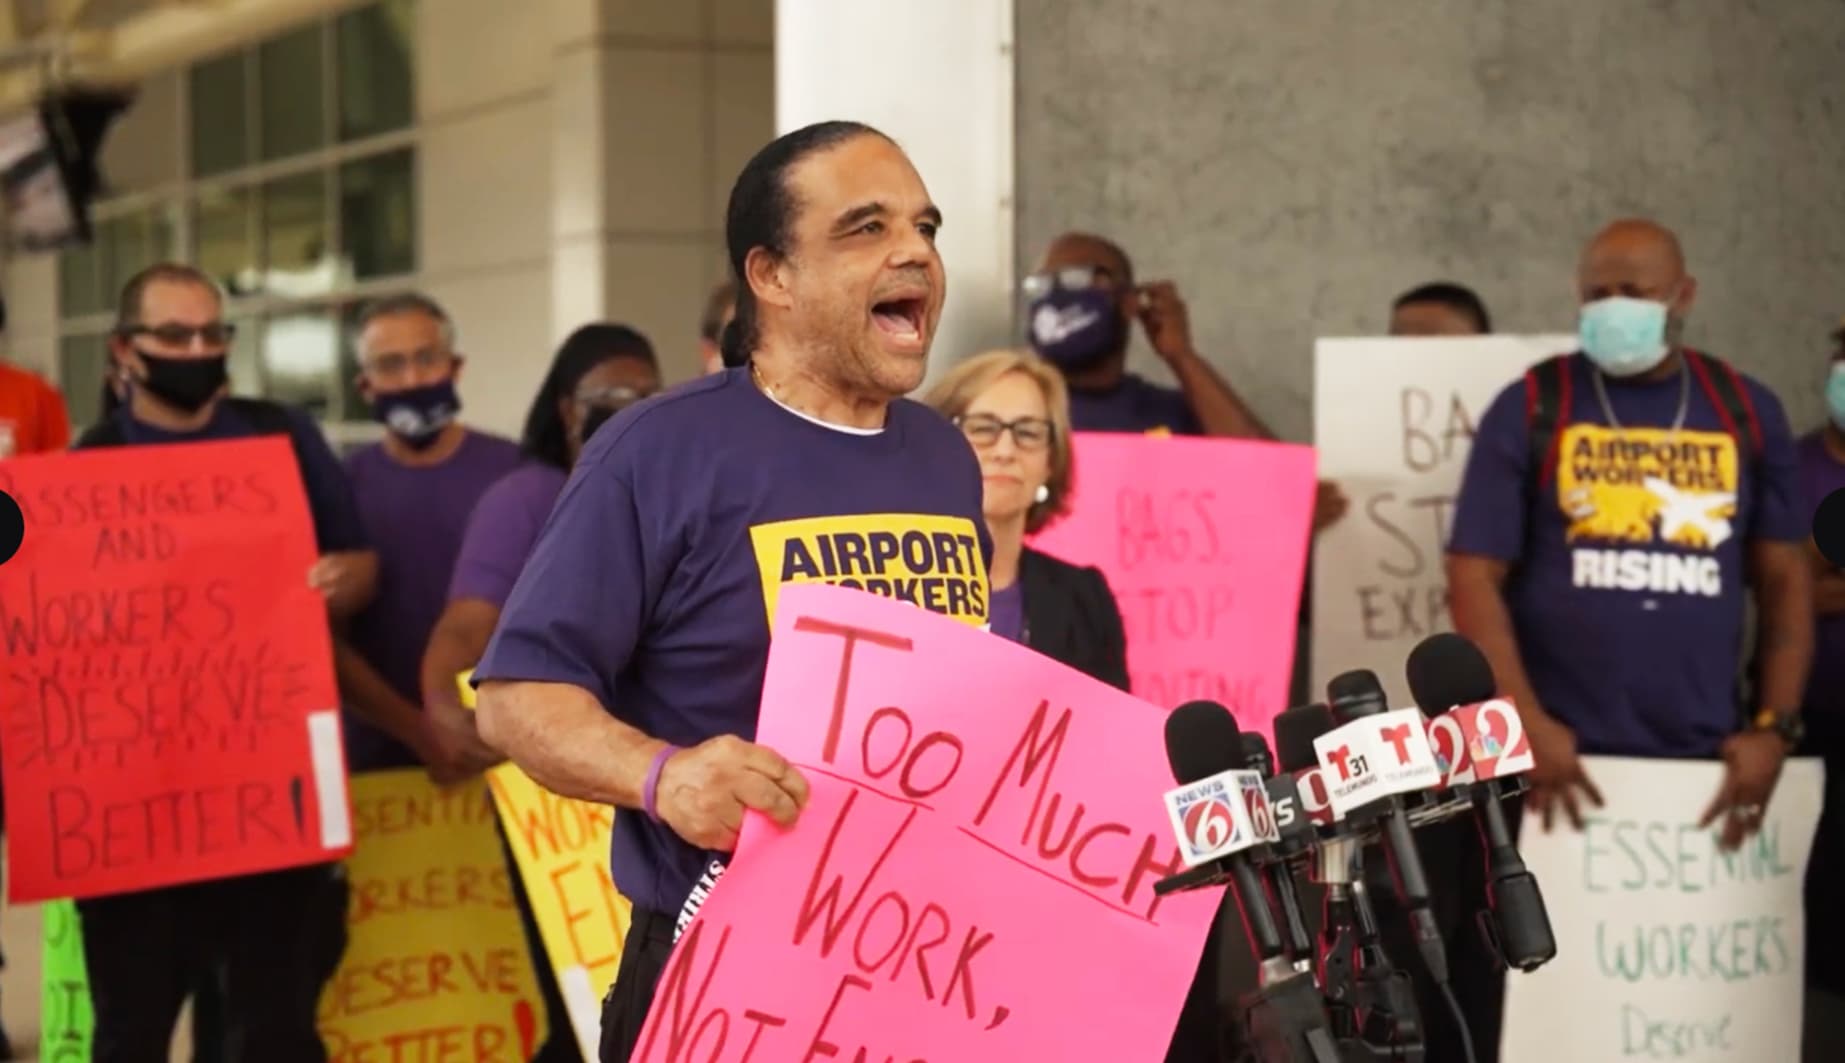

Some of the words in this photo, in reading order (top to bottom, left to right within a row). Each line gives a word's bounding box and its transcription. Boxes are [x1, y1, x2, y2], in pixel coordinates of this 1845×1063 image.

[1573, 436, 1724, 467] AIRPORT
[93, 526, 176, 569] AND
[781, 530, 979, 582] AIRPORT
[1572, 549, 1722, 597] RISING
[0, 569, 236, 657] WORKERS
[1114, 583, 1236, 645] TOP
[39, 660, 288, 765] DESERVE
[1475, 698, 1535, 777] 2
[1350, 755, 1369, 777] 31
[1428, 714, 1476, 787] 2
[48, 776, 304, 880] BETTER!
[973, 699, 1182, 920] MUCH
[1175, 780, 1225, 806] NEWS
[792, 786, 1010, 1032] WORK,
[1594, 914, 1792, 983] WORKERS
[638, 918, 787, 1063] NOT
